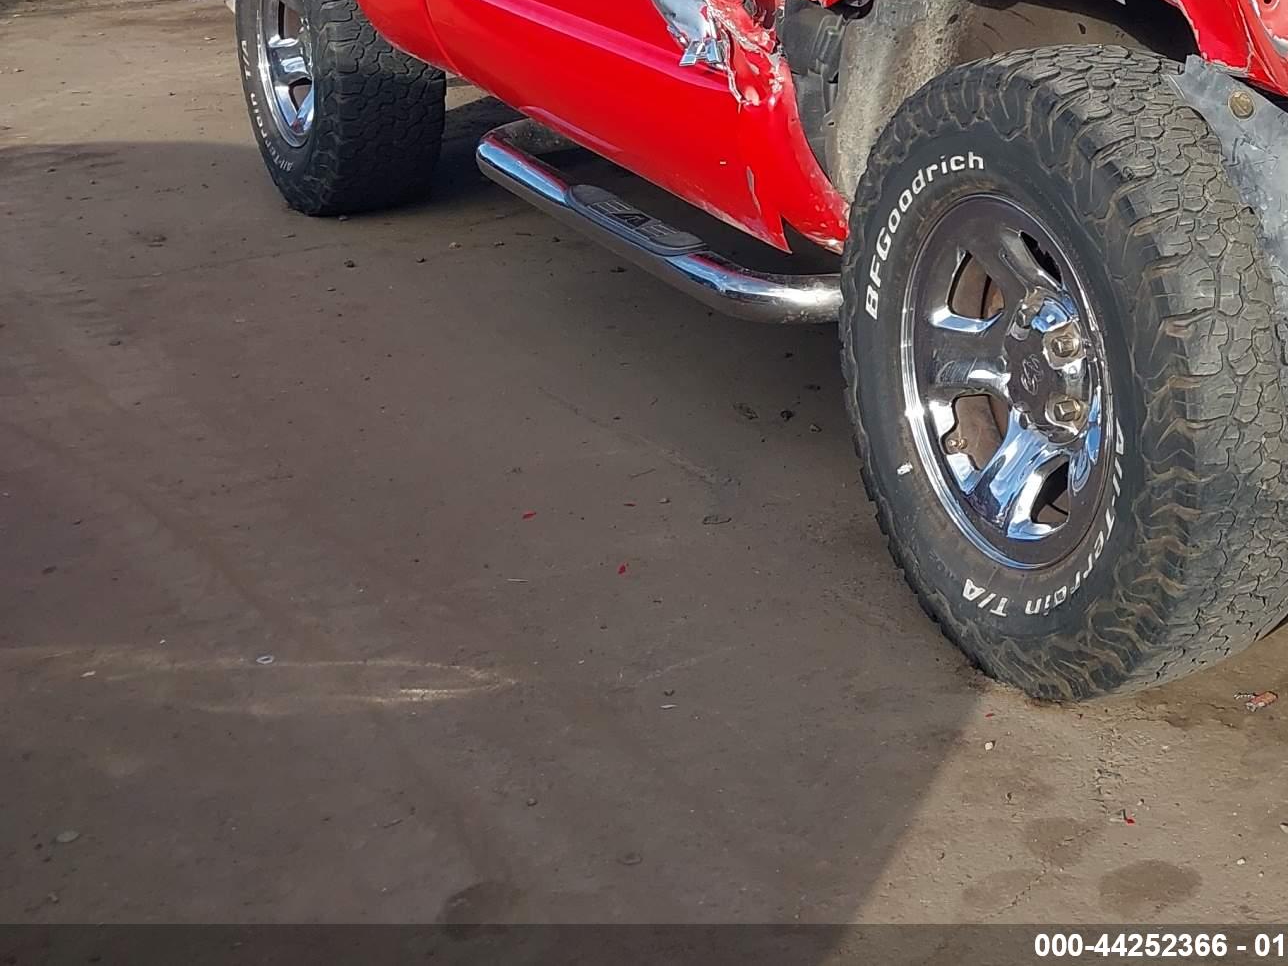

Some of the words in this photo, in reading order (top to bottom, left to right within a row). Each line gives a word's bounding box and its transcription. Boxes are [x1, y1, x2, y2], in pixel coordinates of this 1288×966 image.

[865, 151, 985, 321] BFGoodrich
[962, 578, 1009, 618] T/A
[1024, 418, 1125, 616] All-Terrain
